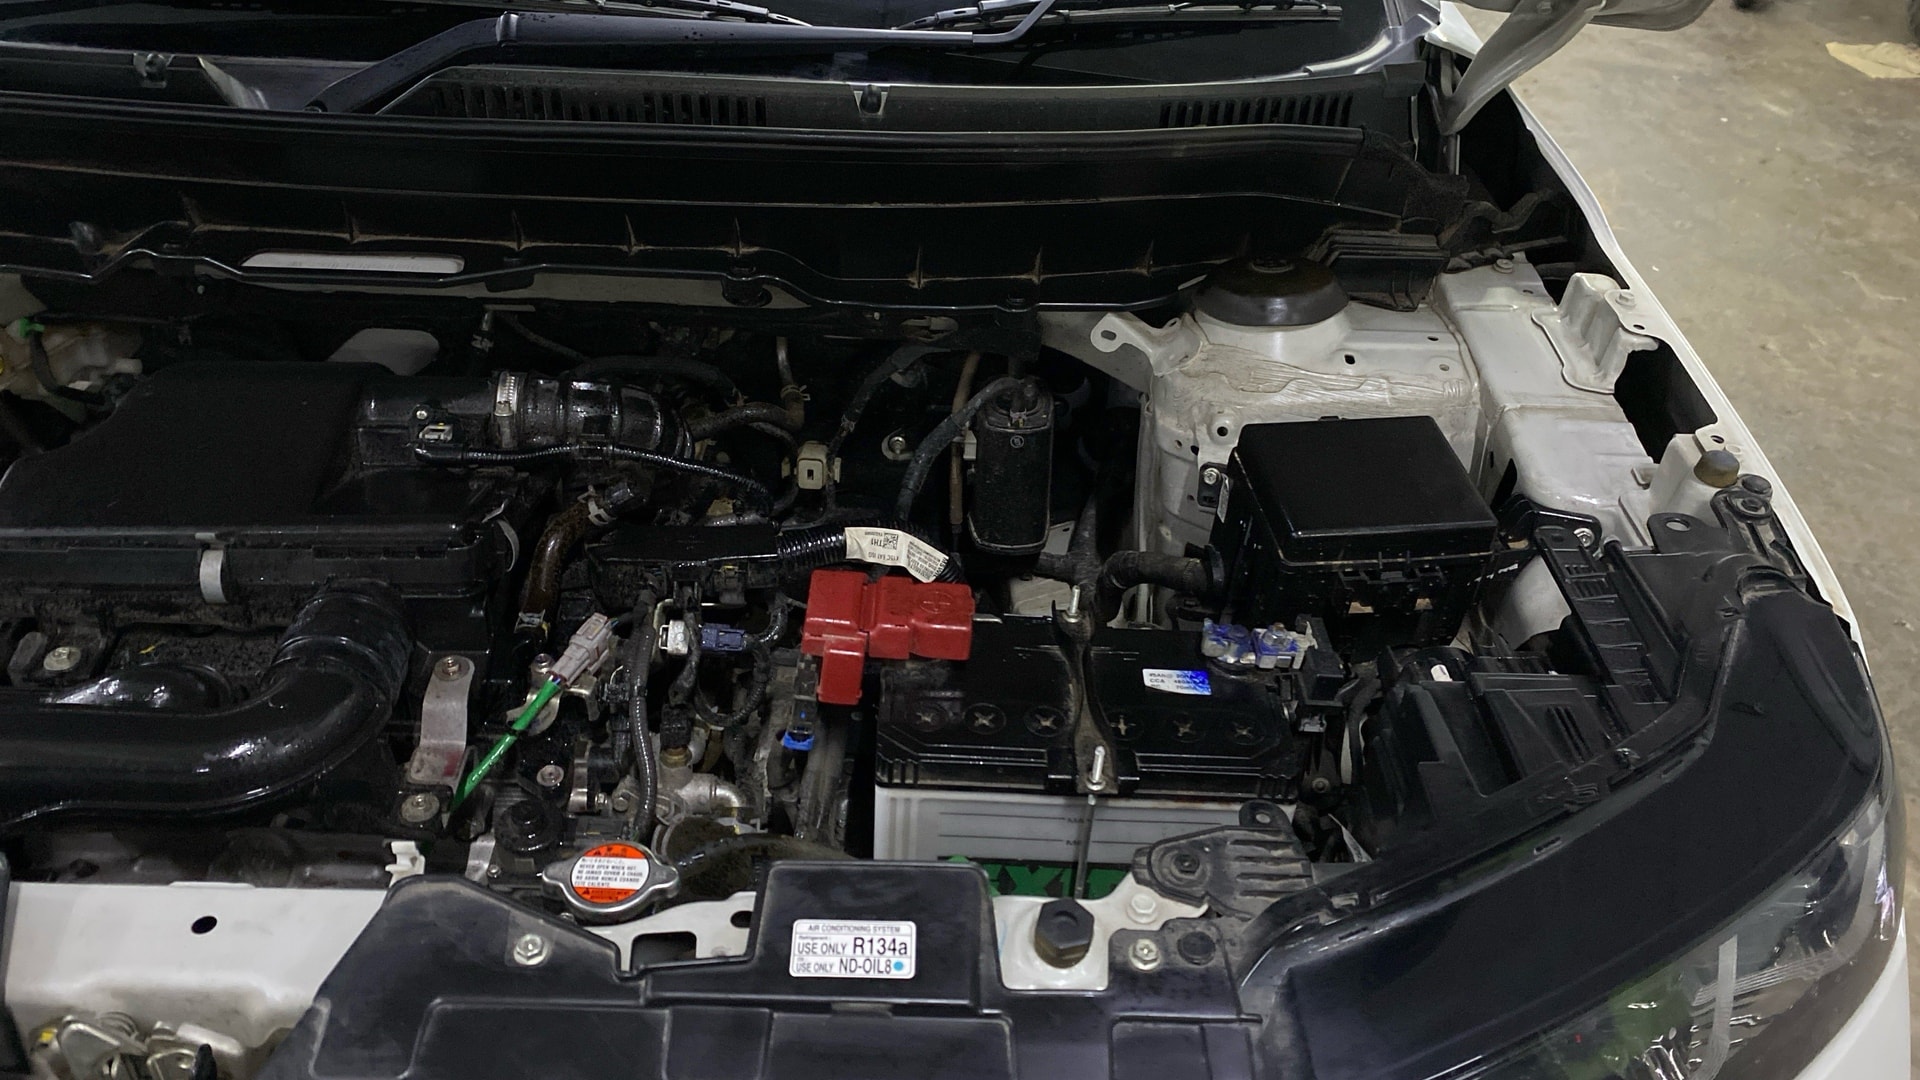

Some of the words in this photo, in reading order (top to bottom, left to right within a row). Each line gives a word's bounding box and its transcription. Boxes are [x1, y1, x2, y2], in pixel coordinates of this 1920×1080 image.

[821, 924, 871, 933] CONDITIONING
[797, 942, 818, 955] USE
[821, 943, 847, 955] ONLY
[853, 937, 908, 955] R134a
[796, 962, 812, 973] USE
[813, 963, 834, 973] ONLY
[839, 958, 892, 975] ND-OIL8
